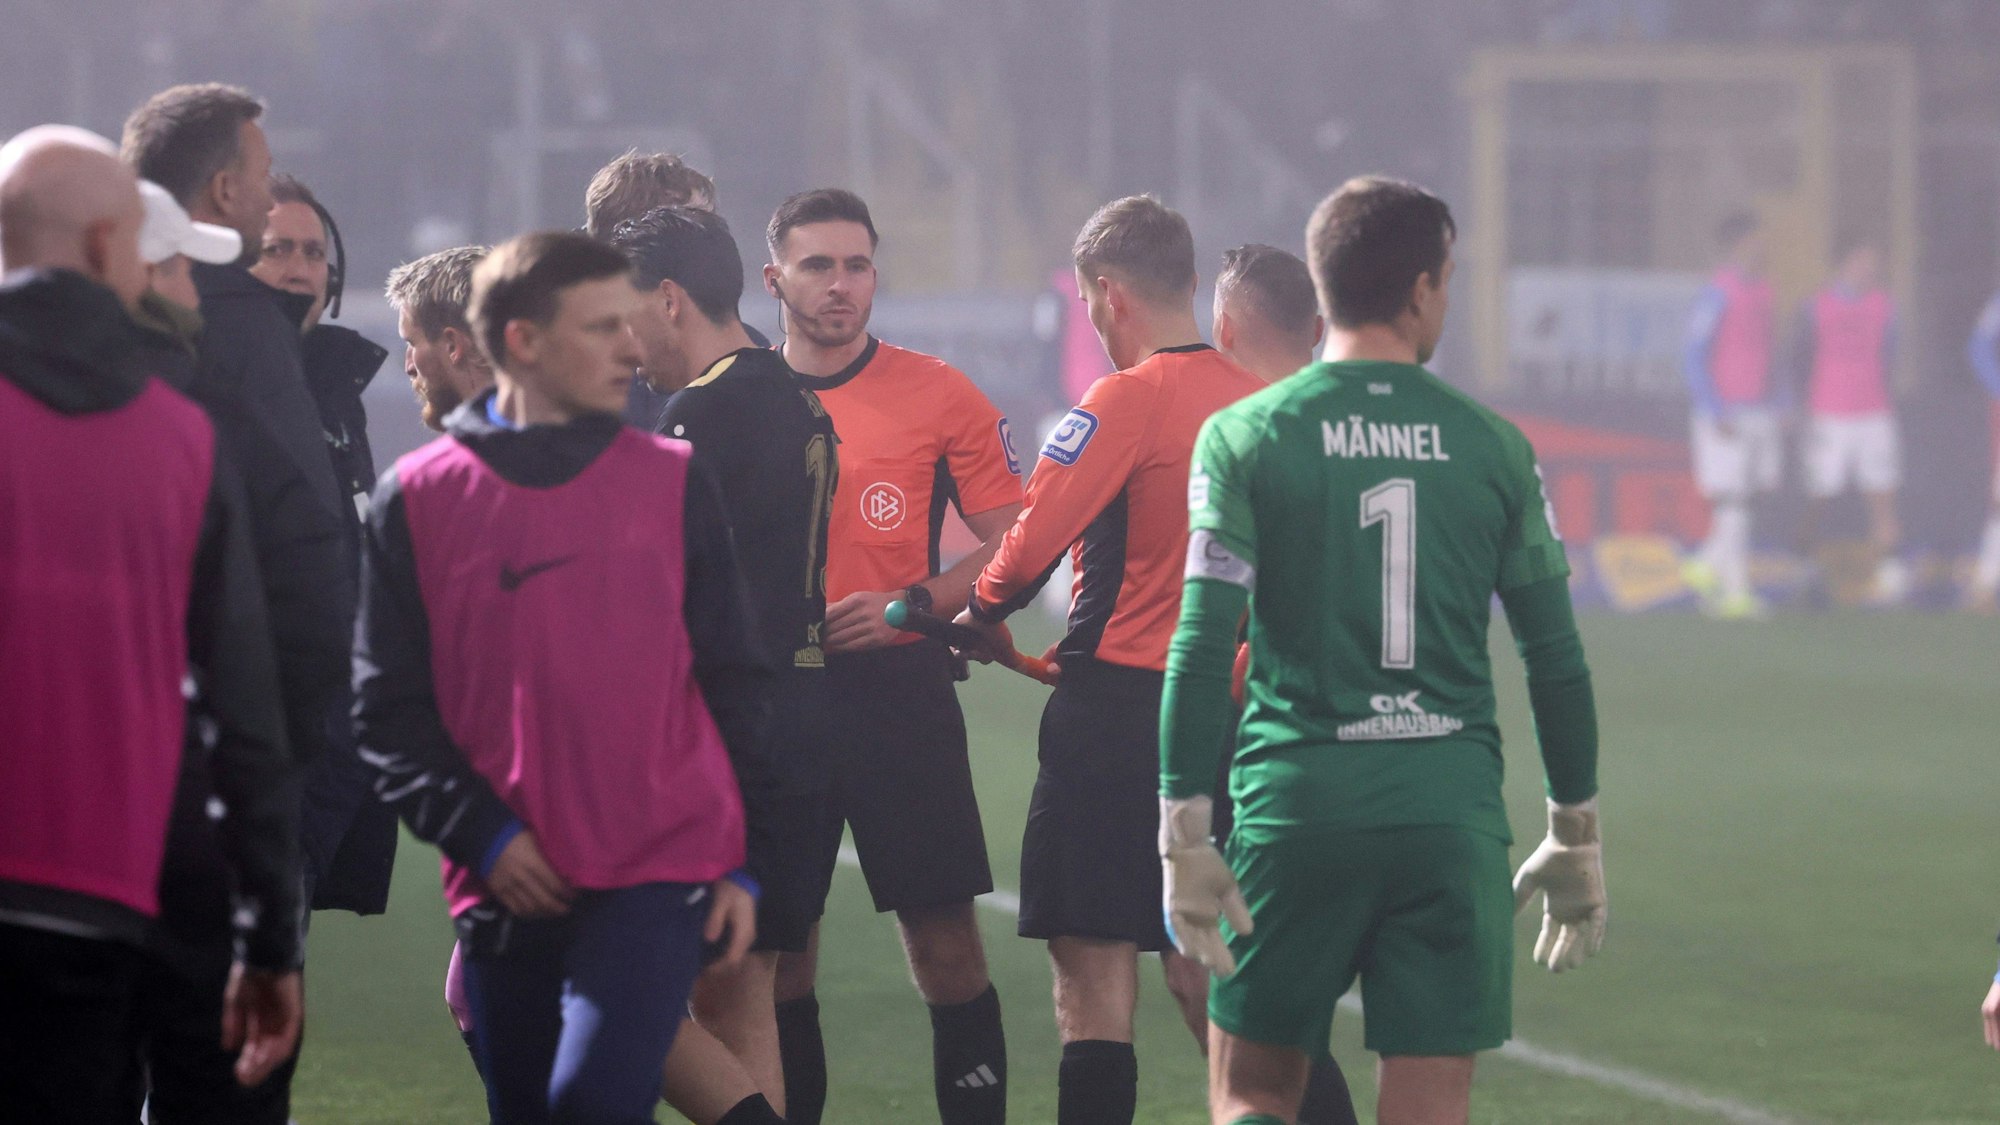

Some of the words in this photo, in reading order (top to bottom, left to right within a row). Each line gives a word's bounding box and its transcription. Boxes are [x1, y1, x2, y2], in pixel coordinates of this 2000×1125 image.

[1321, 415, 1449, 461] MÄNNEL
[1360, 478, 1415, 669] 1
[1369, 690, 1426, 716] OK
[1337, 713, 1463, 738] INNENAUSBAU
